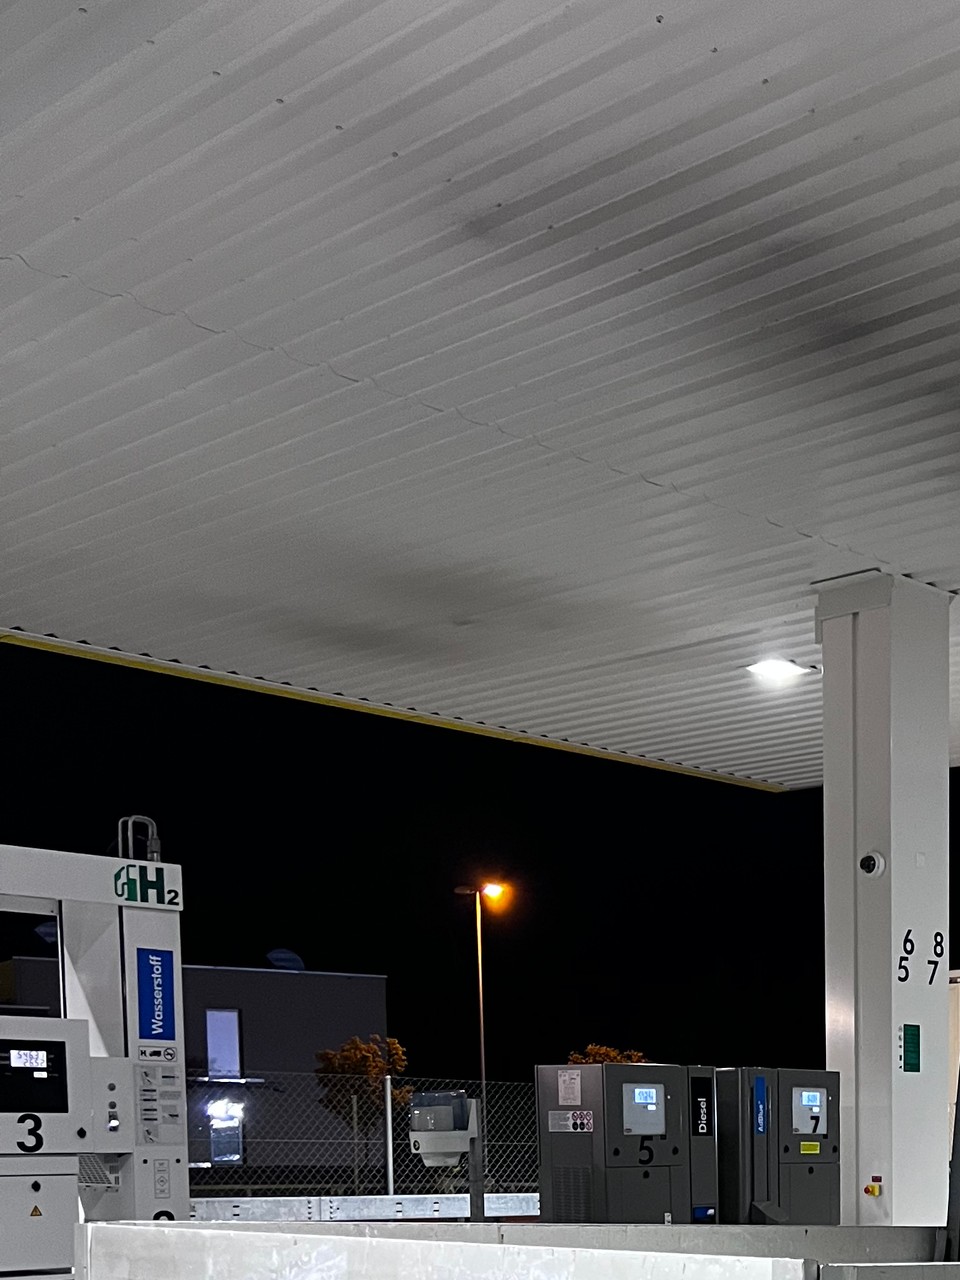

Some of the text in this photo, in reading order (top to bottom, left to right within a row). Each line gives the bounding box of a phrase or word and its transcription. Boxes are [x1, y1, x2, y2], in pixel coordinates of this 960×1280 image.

[903, 929, 945, 958] 6 8
[897, 956, 939, 986] 5 7
[148, 954, 164, 1035] Wasserstoff
[697, 1097, 707, 1133] Diesel
[809, 1115, 821, 1134] 7
[16, 1113, 44, 1153] 3
[638, 1135, 654, 1165] 5
